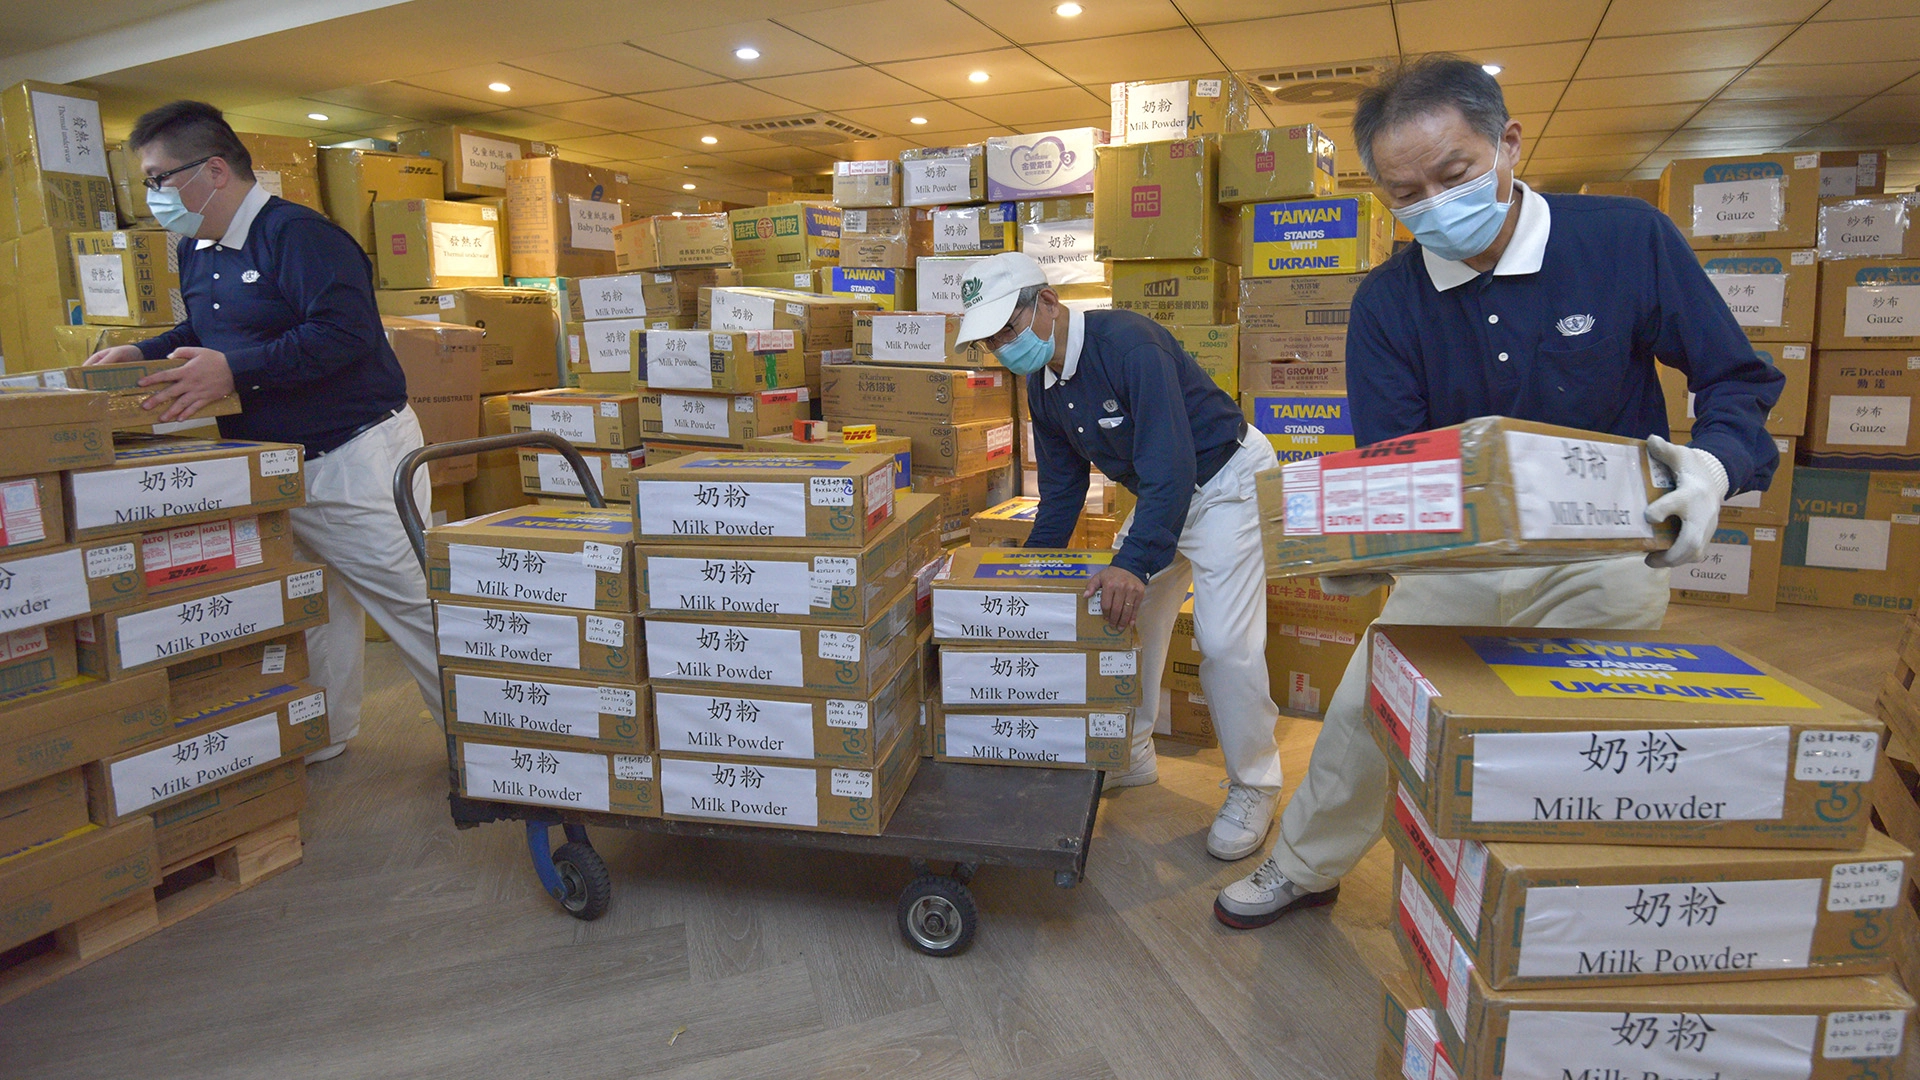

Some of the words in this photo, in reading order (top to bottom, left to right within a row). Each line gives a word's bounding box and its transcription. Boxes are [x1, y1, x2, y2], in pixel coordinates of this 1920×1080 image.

[1142, 98, 1172, 114] 奶粉
[58, 105, 68, 130] Thermal
[1129, 121, 1150, 132] Milk
[1151, 117, 1185, 130] Powder
[72, 117, 91, 156] 發熱衣
[470, 158, 489, 169] Baby
[924, 165, 947, 179] 奶粉
[1711, 165, 1775, 182] YASCO
[915, 184, 931, 194] Milk
[932, 183, 957, 193] Powder
[1721, 191, 1750, 204] 紗布
[1270, 207, 1341, 225] TAIWAN
[1716, 210, 1755, 222] Gauze
[1846, 214, 1875, 228] 紗布
[577, 222, 594, 234] Baby
[735, 222, 757, 239] 蔬菜
[775, 217, 799, 234] 餅乾
[943, 223, 968, 236] 奶粉
[1283, 230, 1325, 241] STANDS
[450, 236, 483, 248] 發熱衣
[1047, 234, 1076, 248] 奶粉
[1290, 240, 1318, 250] WITH
[1840, 232, 1880, 243] Gauze
[935, 243, 952, 251] Milk
[952, 242, 980, 251] Powder
[1037, 255, 1057, 265] Milk
[1058, 253, 1088, 264] Powder
[1268, 256, 1339, 270] UKRAINE
[91, 268, 114, 281] 發熱衣
[842, 268, 886, 281] TAIWAN
[850, 285, 876, 293] STANDS
[1144, 280, 1176, 296] KLIM
[1727, 284, 1756, 297] 紗布
[601, 289, 623, 303] 奶粉
[854, 293, 872, 301] WITH
[932, 292, 949, 300] Milk
[1872, 296, 1900, 308] 紗布
[595, 307, 609, 317] Milk
[610, 305, 634, 315] Powder
[731, 306, 754, 322] 奶粉
[1866, 313, 1904, 325] Gauze
[895, 321, 922, 336] 奶粉
[605, 331, 626, 343] 奶粉
[666, 338, 687, 352] 奶粉
[885, 341, 901, 350] Milk
[904, 341, 931, 351] Powder
[599, 348, 615, 358] Milk
[658, 357, 674, 367] Milk
[674, 357, 699, 367] Powder
[1286, 367, 1316, 376] GROW
[1316, 367, 1329, 375] UP
[1858, 367, 1903, 376] Dr.clean
[413, 396, 432, 404] TAPE
[433, 394, 474, 403] SUBSTRATES
[682, 400, 705, 415] 奶粉
[1270, 404, 1341, 419] TAIWAN
[1855, 406, 1882, 418] 紗布
[551, 410, 573, 423] 奶粉
[674, 418, 692, 429] Milk
[693, 419, 717, 430] Powder
[932, 428, 952, 436] CS3P
[1284, 425, 1325, 434] STANDS
[1849, 422, 1887, 433] Gauze
[1291, 435, 1318, 444] WITH
[1561, 440, 1607, 481] 奶粉
[139, 465, 198, 494] 奶粉
[551, 476, 566, 486] Milk
[694, 484, 750, 509] 奶粉
[114, 506, 156, 525] Milk
[162, 498, 223, 518] Powder
[1550, 501, 1584, 526] Milk
[1587, 504, 1631, 526] Powder
[1796, 499, 1858, 516] YOHO
[1372, 513, 1405, 525] STOP
[1418, 511, 1454, 523] ALTO
[142, 535, 164, 546] ALTO
[173, 529, 196, 540] STOP
[202, 523, 228, 534] HALTE
[672, 519, 710, 536] Milk
[715, 521, 775, 536] Powder
[1834, 543, 1860, 552] Gauze
[496, 548, 547, 575] 奶粉
[168, 564, 211, 580] DHL
[701, 560, 756, 585] 奶粉
[1690, 568, 1727, 580] Gauze
[476, 579, 509, 598] Milk
[514, 583, 568, 603] Powder
[177, 594, 234, 626] 奶粉
[680, 594, 718, 611] Milk
[721, 598, 780, 614] Powder
[980, 595, 1030, 617] 奶粉
[482, 610, 531, 635] 奶粉
[156, 637, 196, 658] Milk
[199, 620, 258, 646] Powder
[961, 623, 993, 638] Milk
[999, 626, 1050, 640] Powder
[16, 640, 41, 653] ALTO
[696, 627, 750, 653] 奶粉
[465, 641, 496, 657] Milk
[500, 645, 552, 662] Powder
[1508, 642, 1700, 660] TAIWAN
[676, 661, 713, 678] Milk
[716, 665, 773, 681] Powder
[990, 656, 1040, 679] 奶粉
[1565, 659, 1678, 671] STANDS
[1593, 669, 1673, 680] WITH
[501, 680, 551, 706] 奶粉
[970, 687, 1003, 700] Milk
[1007, 687, 1060, 701] Powder
[1549, 680, 1765, 700] UKRAINE
[707, 699, 761, 723] 奶粉
[483, 710, 515, 728] Milk
[520, 715, 572, 734] Powder
[991, 717, 1040, 740] 奶粉
[172, 731, 230, 766] 奶粉
[687, 731, 723, 748] Milk
[727, 735, 784, 751] Powder
[972, 745, 1003, 759] Milk
[1008, 747, 1060, 763] Powder
[1579, 732, 1687, 774] 奶粉
[510, 749, 561, 775] 奶粉
[151, 775, 191, 800] Milk
[196, 754, 254, 785] Powder
[711, 764, 765, 789] 奶粉
[492, 779, 524, 797] Milk
[528, 784, 583, 801] Powder
[691, 796, 727, 813] Milk
[730, 800, 788, 817] Powder
[1532, 796, 1603, 820] Milk
[1615, 795, 1727, 820] Powder
[1409, 824, 1437, 872] DHL
[1625, 886, 1726, 928] 奶粉
[1577, 950, 1644, 974] Milk
[1653, 946, 1758, 972] Powder
[1611, 1012, 1717, 1052] 奶粉
